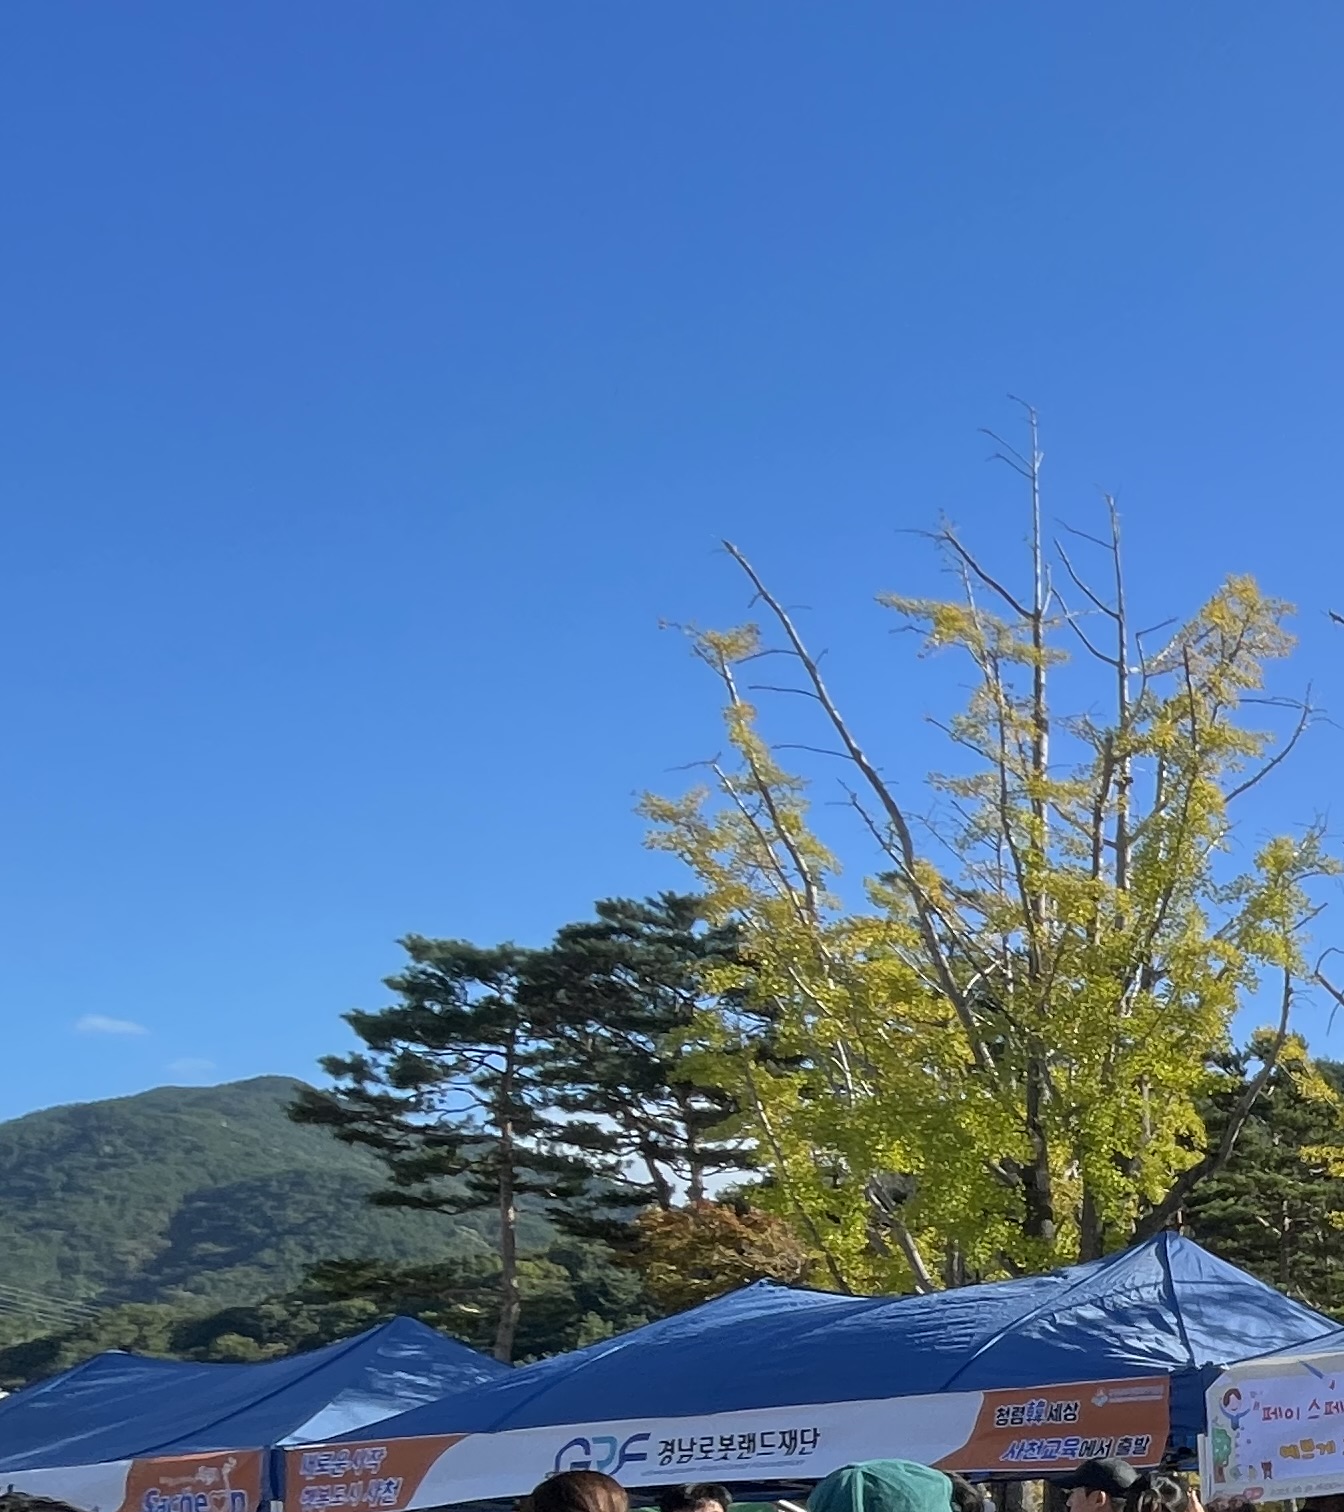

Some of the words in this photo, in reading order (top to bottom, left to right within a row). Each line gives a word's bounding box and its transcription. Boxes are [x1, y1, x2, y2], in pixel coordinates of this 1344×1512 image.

[1048, 1401, 1080, 1424] 세상
[657, 1427, 821, 1466] 경남로봇랜드재단
[1115, 1435, 1151, 1456] 출발
